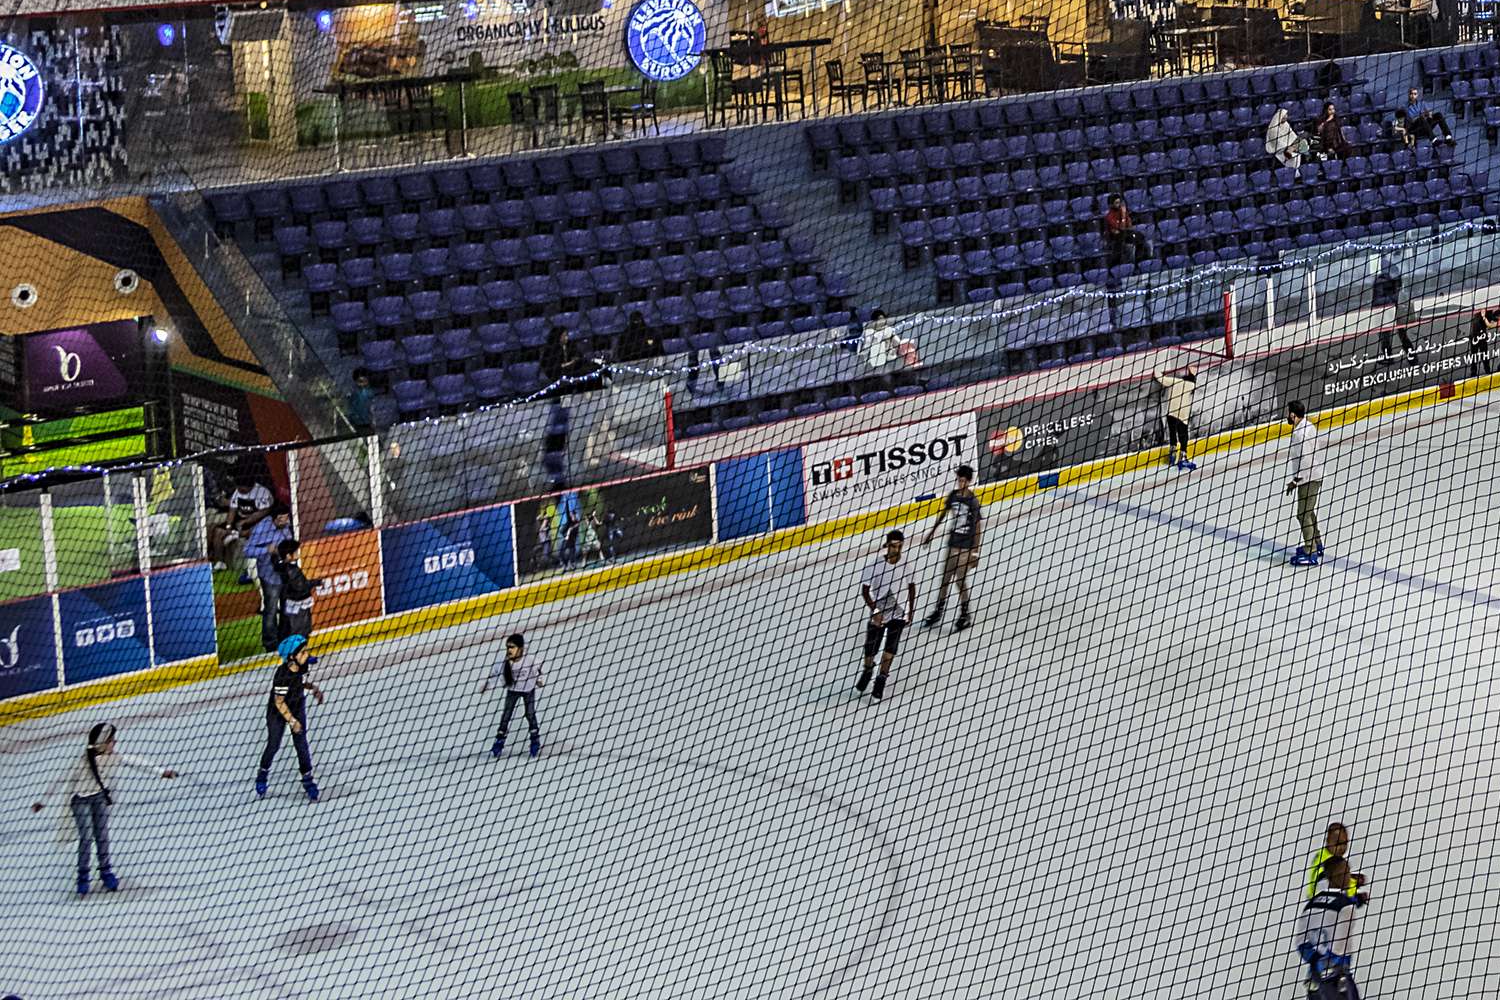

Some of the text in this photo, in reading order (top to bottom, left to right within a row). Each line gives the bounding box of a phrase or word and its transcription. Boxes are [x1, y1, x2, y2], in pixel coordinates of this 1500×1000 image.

[457, 20, 542, 42] ORGANICALLY
[640, 53, 699, 79] BURGER
[1324, 349, 1490, 395] ENJOY EXCLUSIVE OFFERS WITH
[1024, 414, 1094, 437] PRICELESS
[856, 433, 968, 476] TISSOT
[1024, 437, 1059, 450] CITIES
[813, 487, 849, 502] SWISS
[853, 474, 906, 494] WATCHES
[911, 466, 942, 482] SINCE
